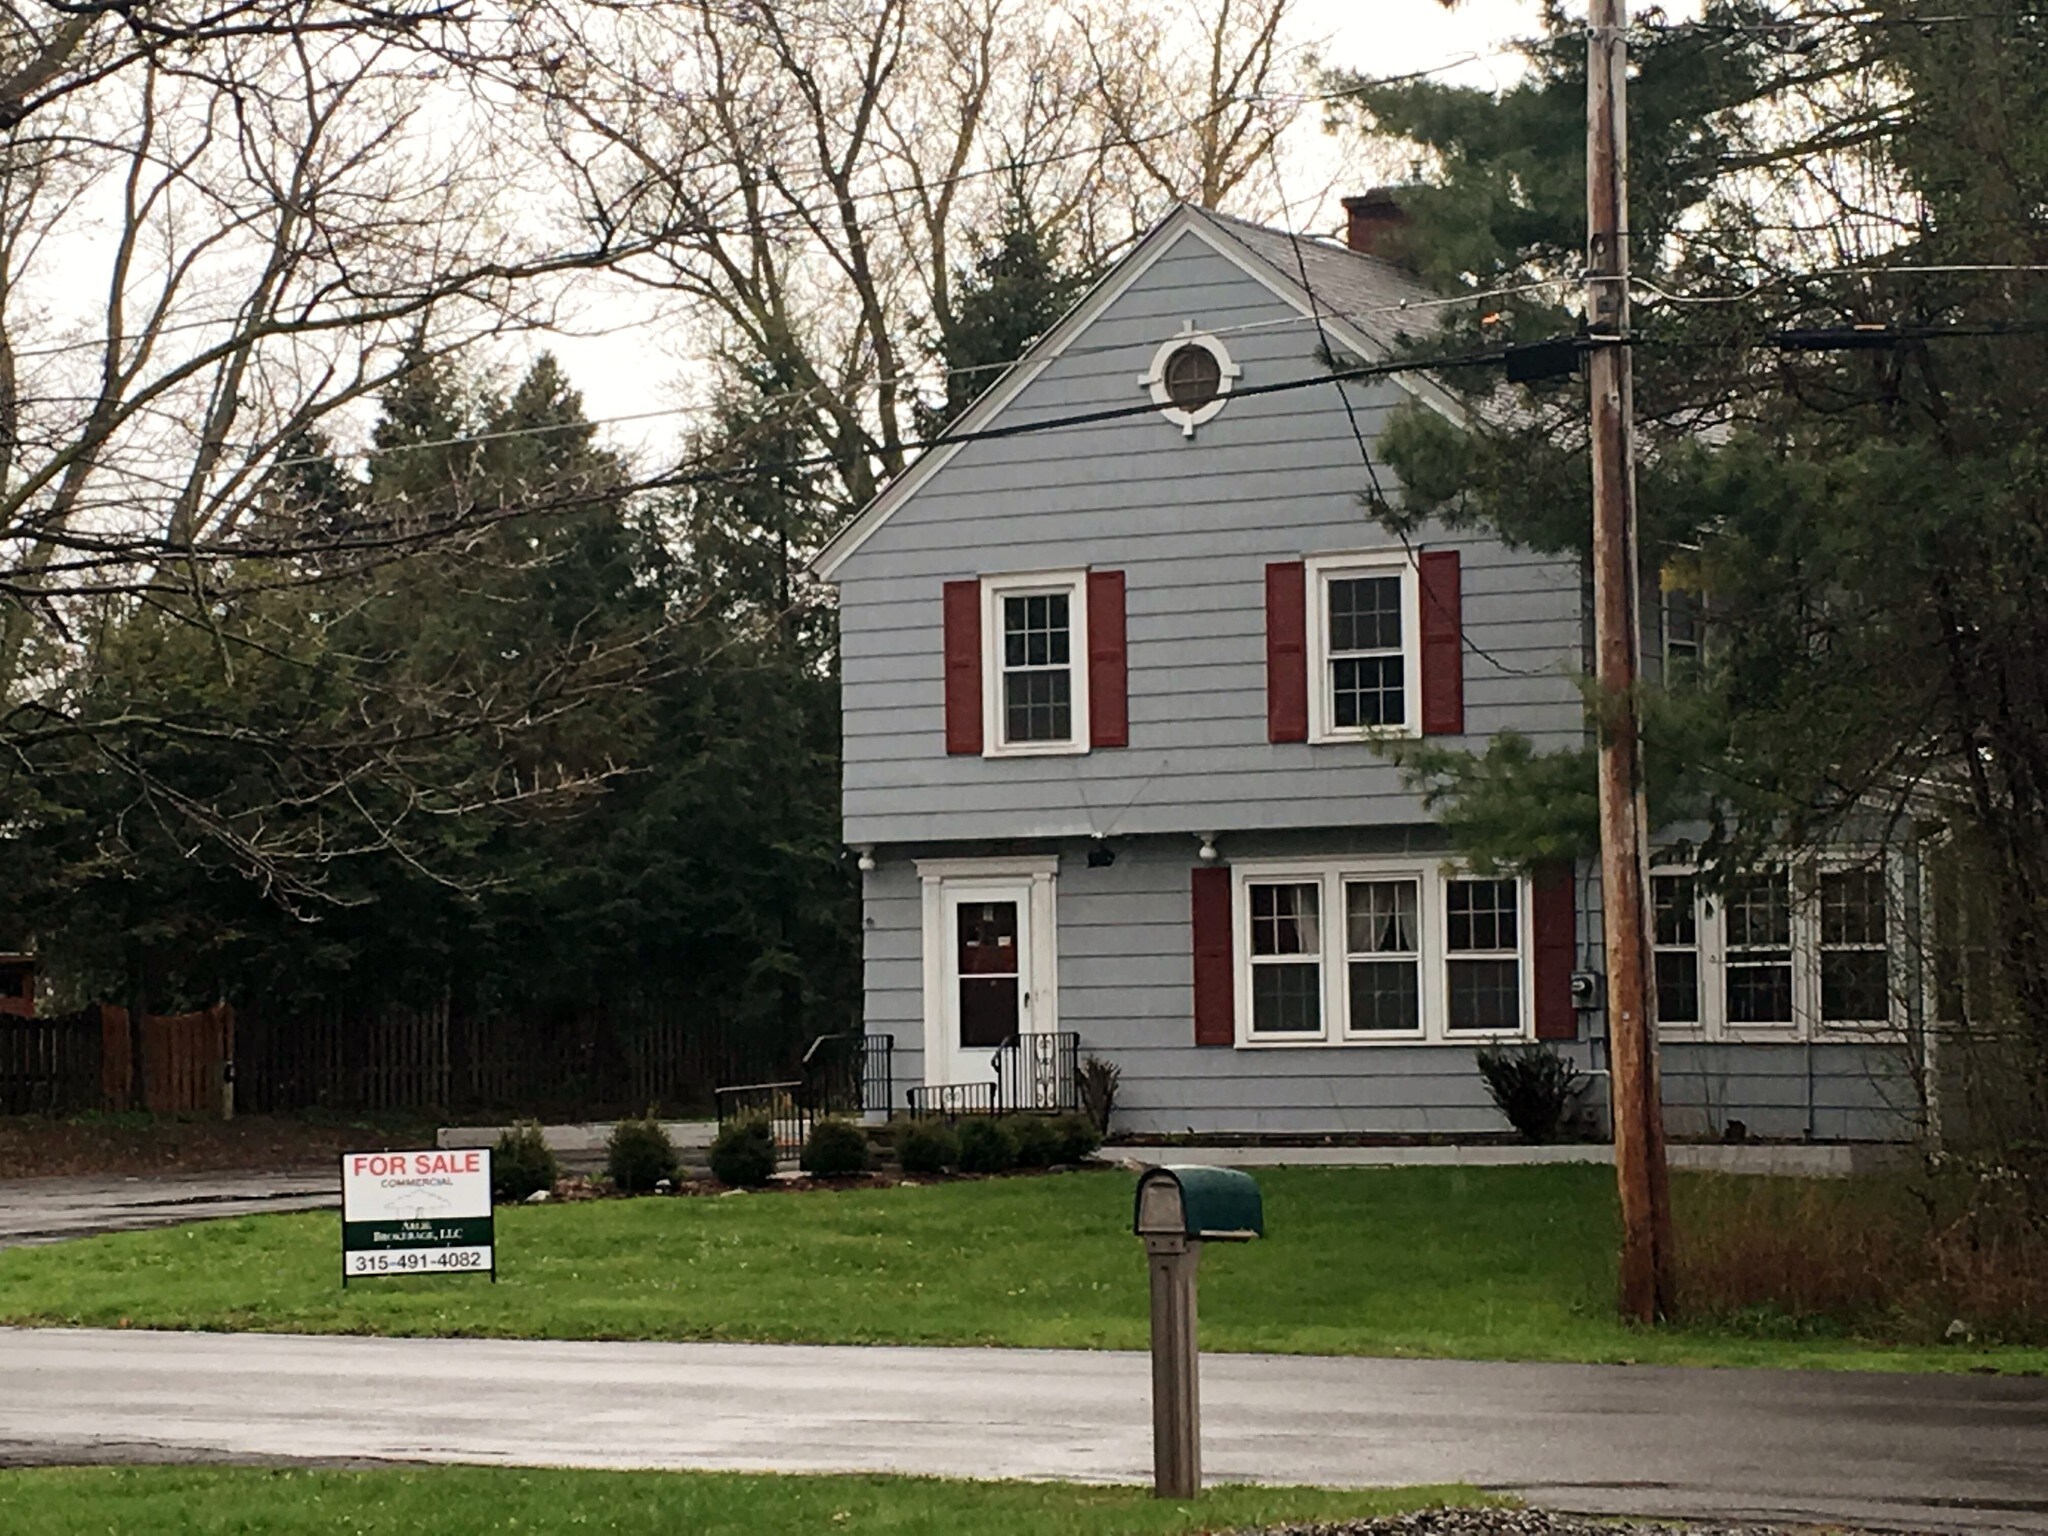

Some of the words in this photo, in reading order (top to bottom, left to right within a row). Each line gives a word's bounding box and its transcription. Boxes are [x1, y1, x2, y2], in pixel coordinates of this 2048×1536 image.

[354, 1157, 406, 1176] FOR
[415, 1153, 480, 1175] SALE
[381, 1178, 453, 1188] COMMERCIAL
[440, 1229, 463, 1239] LLC
[355, 1252, 481, 1271] 315-491-4082
